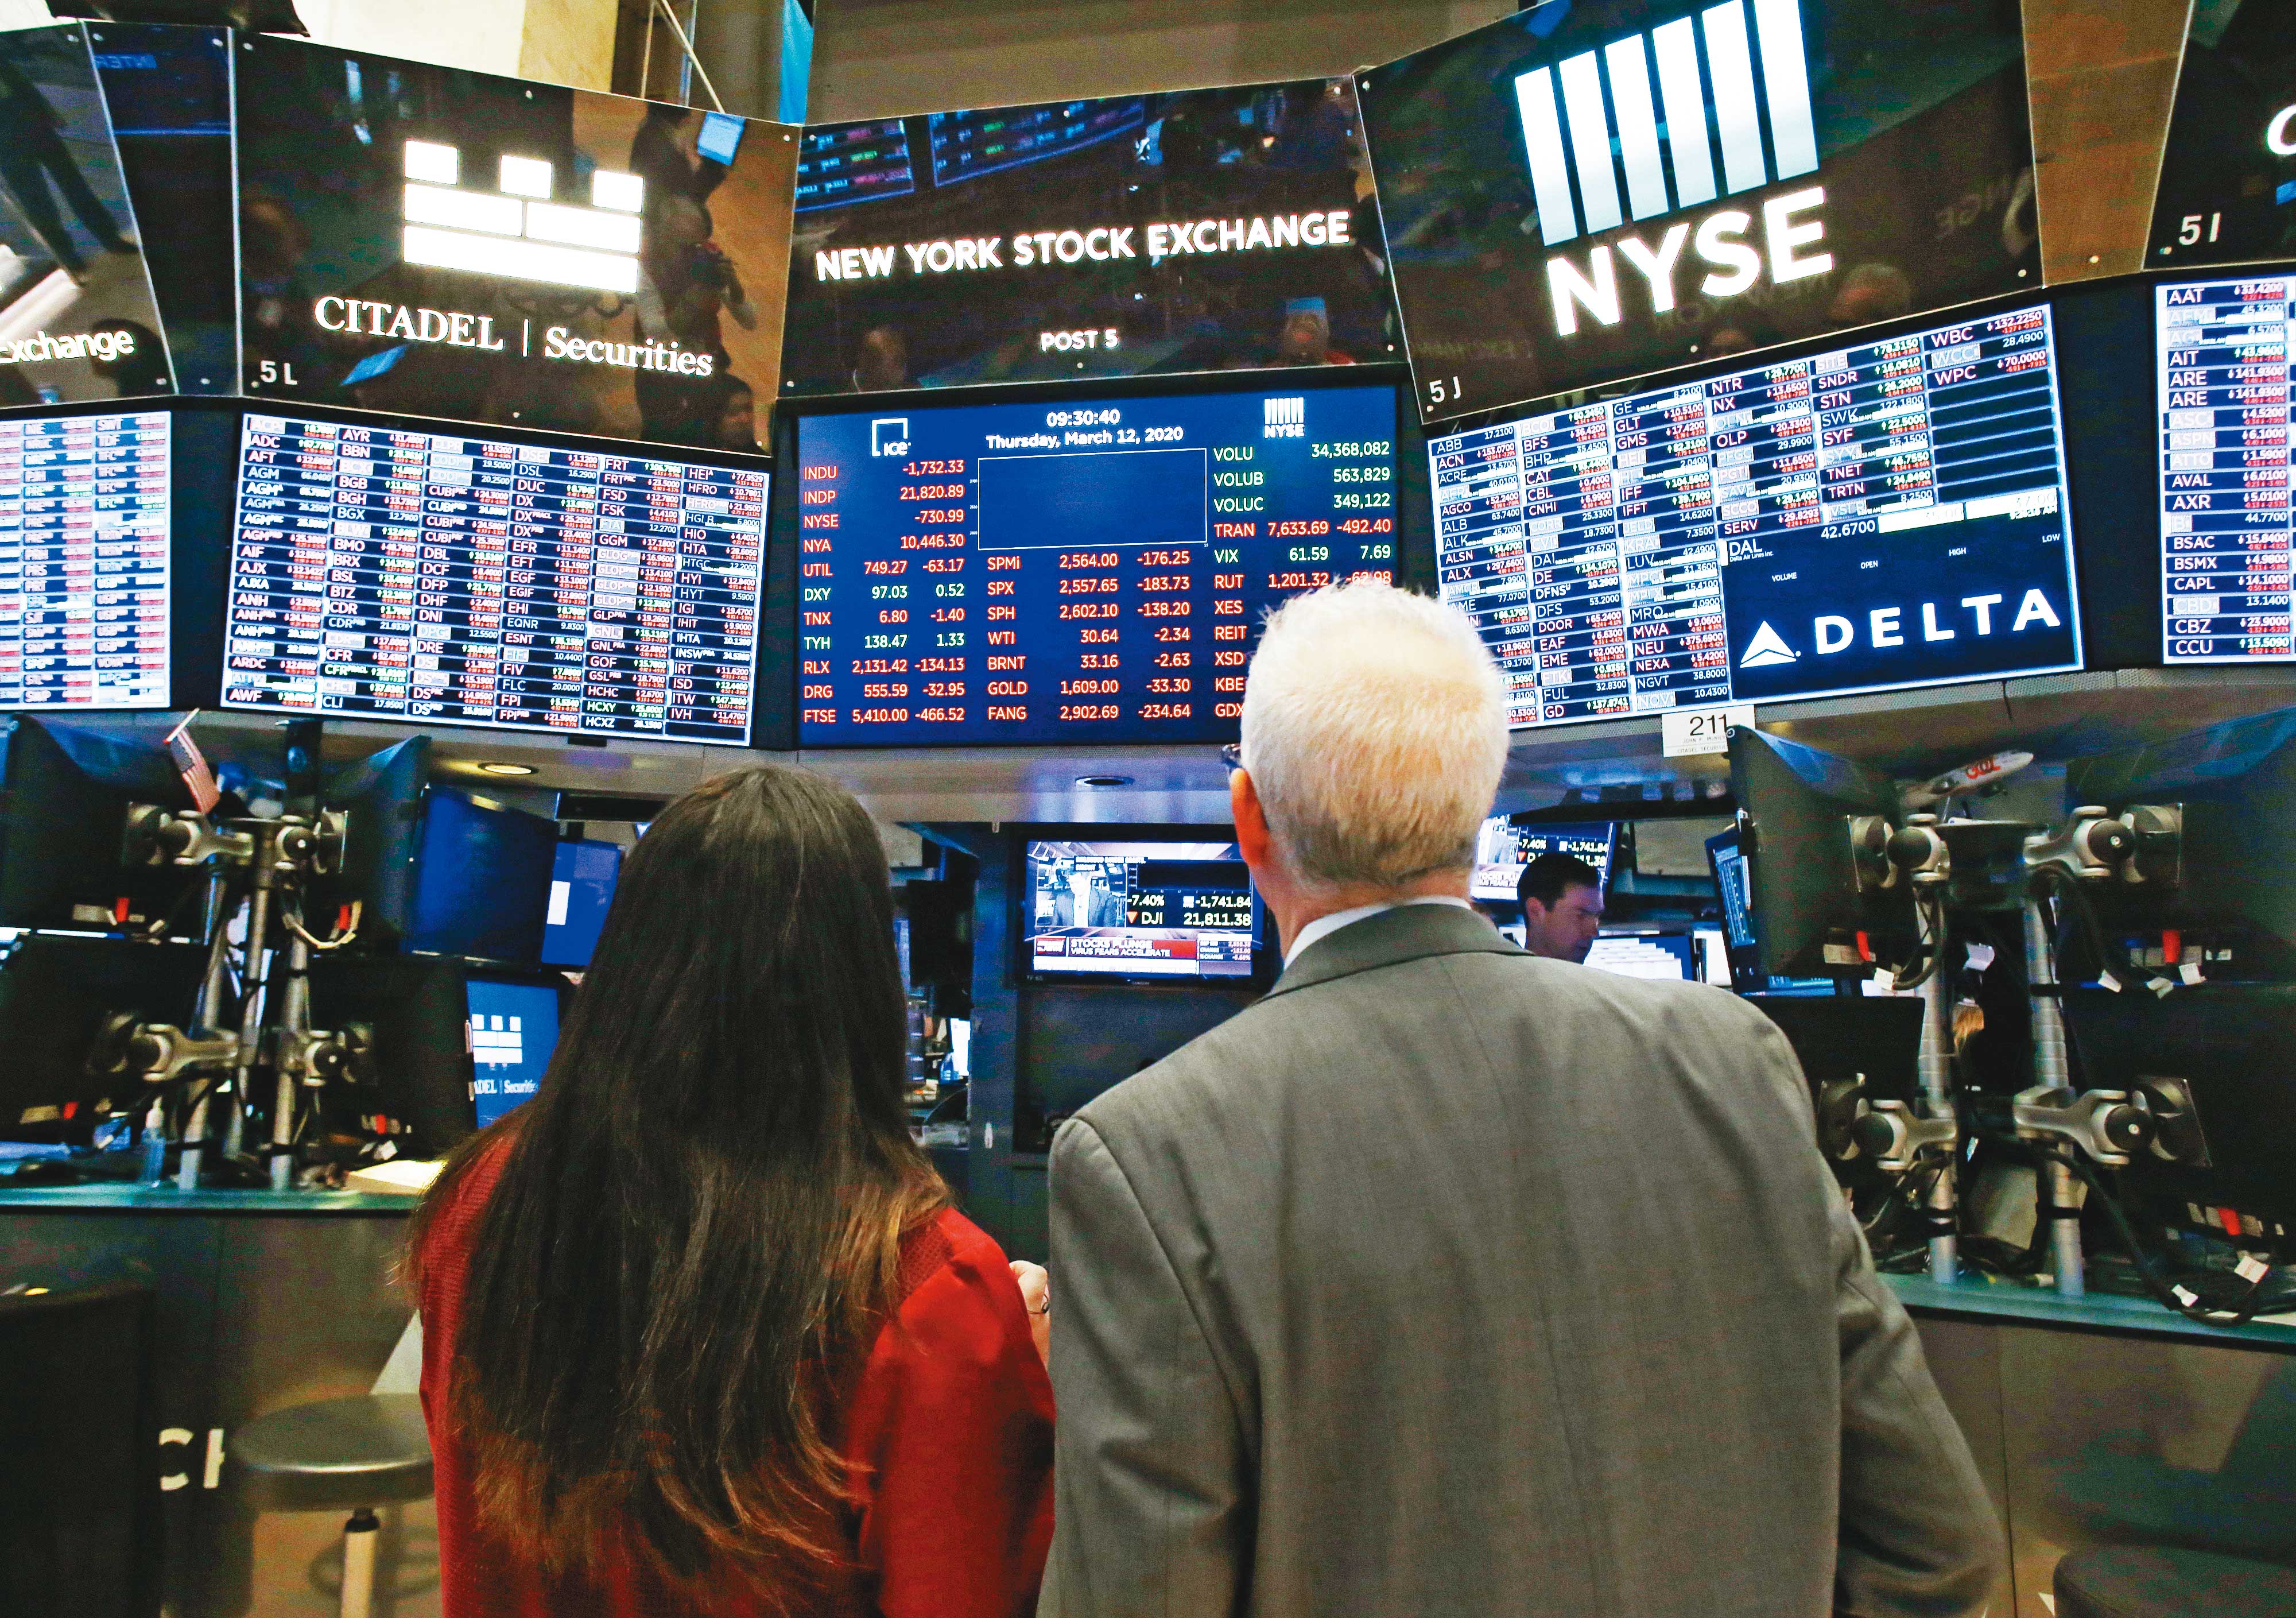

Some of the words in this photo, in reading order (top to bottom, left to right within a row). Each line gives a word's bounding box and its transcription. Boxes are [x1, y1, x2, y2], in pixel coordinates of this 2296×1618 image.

[816, 246, 895, 281] NEW
[903, 237, 1003, 273] YORK
[1013, 227, 1136, 265] STOCK
[1147, 211, 1350, 257] EXCHANGE
[1546, 187, 1834, 336] NYSE
[2169, 289, 2204, 304] AAT
[315, 296, 503, 350] CITADEL
[545, 327, 712, 377] Securities
[1040, 330, 1099, 351] POST
[1105, 328, 1118, 349] 5
[1931, 328, 1974, 347] WBC
[2003, 331, 2043, 348] 28.4900
[2170, 350, 2198, 366] AIT
[1935, 366, 1976, 385] WPC
[1712, 378, 1742, 395] NTR
[1046, 409, 1120, 427] 09:30:40
[986, 433, 1061, 448] Thursday,
[1064, 430, 1112, 446] March
[1117, 429, 1139, 444] 12,
[1145, 426, 1184, 442] 2020
[1264, 424, 1304, 438] NYSE
[1716, 431, 1747, 447] OLP
[1437, 439, 1463, 454] ABB
[1484, 427, 1513, 440] 17.2100
[1617, 435, 1647, 448] GMS
[1213, 446, 1253, 462] VOLU
[1311, 441, 1390, 459] 34,368,082
[804, 466, 836, 480] INDU
[903, 459, 964, 476] -1,732.33
[1213, 471, 1263, 487] VOLUB
[1333, 467, 1390, 483] 563,829
[1826, 464, 1862, 480] TNET
[2173, 474, 2213, 487] AVAL
[804, 490, 836, 504] INDP
[900, 485, 964, 501] 21,820.89
[1213, 497, 1264, 513] VOLUC
[1333, 493, 1390, 509] 349,122
[804, 514, 839, 528] NYSE
[915, 509, 964, 523] -730.99
[1214, 522, 1254, 537] TRAN
[1268, 521, 1328, 537] 7,633.69
[1337, 518, 1391, 533] -492.40
[804, 539, 831, 552] NYA
[901, 533, 964, 550] 10,446.30
[1729, 539, 1763, 556] DAL
[1821, 520, 1876, 539] 42.6700
[2042, 533, 2061, 543] LOW
[2174, 536, 2214, 549] BSAC
[1214, 549, 1239, 563] VIX
[1289, 547, 1329, 562] 61.59
[1360, 544, 1391, 559] 7.69
[1949, 547, 1967, 556] HIGH
[804, 563, 833, 576] UTIL
[864, 560, 907, 575] 749.27
[922, 558, 964, 572] -63.17
[1060, 553, 1118, 570] 2,564.00
[1137, 551, 1189, 565] -176.25
[1860, 560, 1879, 570] OPEN
[1215, 574, 1244, 589] RUT
[1267, 572, 1329, 589] 1,201.32
[1345, 571, 1392, 585] -6298
[1771, 571, 1797, 582] VOLUME
[804, 587, 831, 601] DXY
[871, 585, 907, 599] 97.03
[936, 583, 964, 597] 0.52
[987, 581, 1014, 595] SPX
[1060, 578, 1118, 594] 2,557.65
[1137, 576, 1189, 591] -183.73
[1215, 600, 1242, 614] XES
[1537, 605, 1562, 617] DFS
[1589, 594, 1620, 605] 53.2000
[2246, 594, 2289, 606] 13.1400
[804, 611, 831, 625] TNX
[880, 610, 907, 623] 6.80
[930, 608, 964, 621] -1.40
[988, 606, 1014, 620] SPH
[1060, 603, 1118, 620] 2,602.10
[1138, 602, 1189, 616] -138.20
[1538, 619, 1572, 632] DOOR
[1633, 624, 1669, 637] MWA
[1814, 589, 2061, 655] DELTA
[2175, 618, 2212, 633] CBZ
[988, 631, 1014, 645] WTI
[1081, 629, 1118, 642] 30.64
[1154, 627, 1190, 641] -2.34
[1215, 625, 1247, 640] REIT
[804, 636, 831, 650] TYH
[864, 634, 907, 648] 138.47
[936, 633, 964, 647] 1.33
[804, 660, 829, 674] RLX
[852, 659, 907, 675] 2,131.42
[915, 657, 964, 671] -134.13
[988, 656, 1026, 670] BRNT
[1080, 655, 1118, 668] 33.16
[1154, 653, 1189, 667] -2.63
[1215, 652, 1244, 665] XSD
[1215, 677, 1244, 692] KBE
[1637, 676, 1669, 688] NGVT
[1693, 668, 1726, 680] 38.8000
[804, 685, 832, 698] DRG
[864, 684, 907, 697] 555.59
[923, 683, 964, 696] -32.95
[988, 681, 1027, 695] GOLD
[1061, 680, 1118, 695] 1,609.00
[1146, 679, 1190, 692] -33.30
[804, 709, 836, 723] FTSE
[852, 709, 907, 723] 5,410.00
[915, 707, 964, 721] -466.52
[988, 706, 1026, 720] FANG
[1060, 705, 1118, 721] 2,902.69
[1138, 704, 1190, 718] -234.64
[1215, 703, 1244, 717] GDX
[1690, 713, 1727, 736] 211
[1127, 894, 1165, 907] -7.40%
[1195, 896, 1251, 908] -1,741.84
[1141, 911, 1163, 924] DJI
[1183, 912, 1251, 927] 21,811.38
[1071, 939, 1111, 949] STOCKS
[1112, 939, 1153, 949] PLUNGE
[1071, 947, 1093, 955] VIRUS
[1094, 947, 1119, 956] FEARS
[1120, 948, 1170, 957] ACCELERATE
